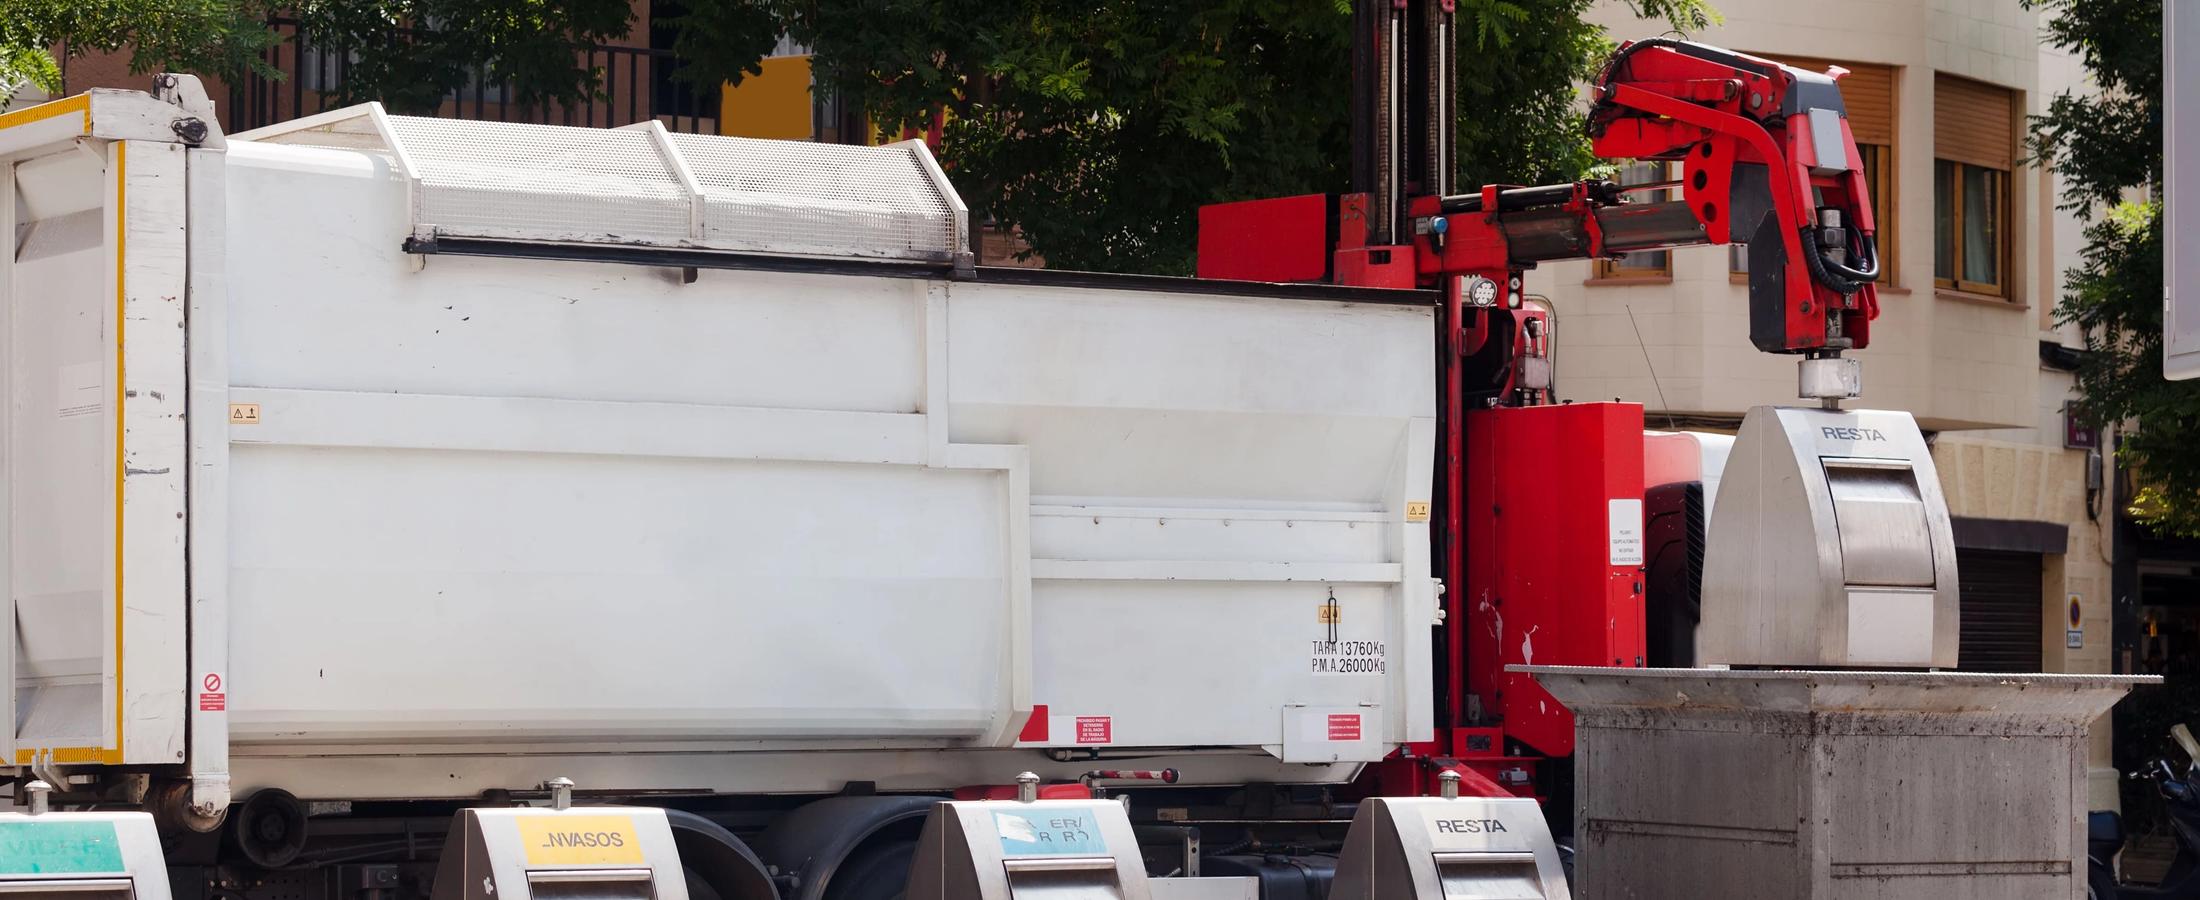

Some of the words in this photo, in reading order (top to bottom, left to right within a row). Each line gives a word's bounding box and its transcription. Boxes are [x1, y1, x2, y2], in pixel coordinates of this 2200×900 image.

[1821, 426, 1887, 441] RESTA
[1312, 641, 1338, 655] TARA
[1436, 819, 1508, 833] RESTA
[542, 832, 624, 847] NVASOS
